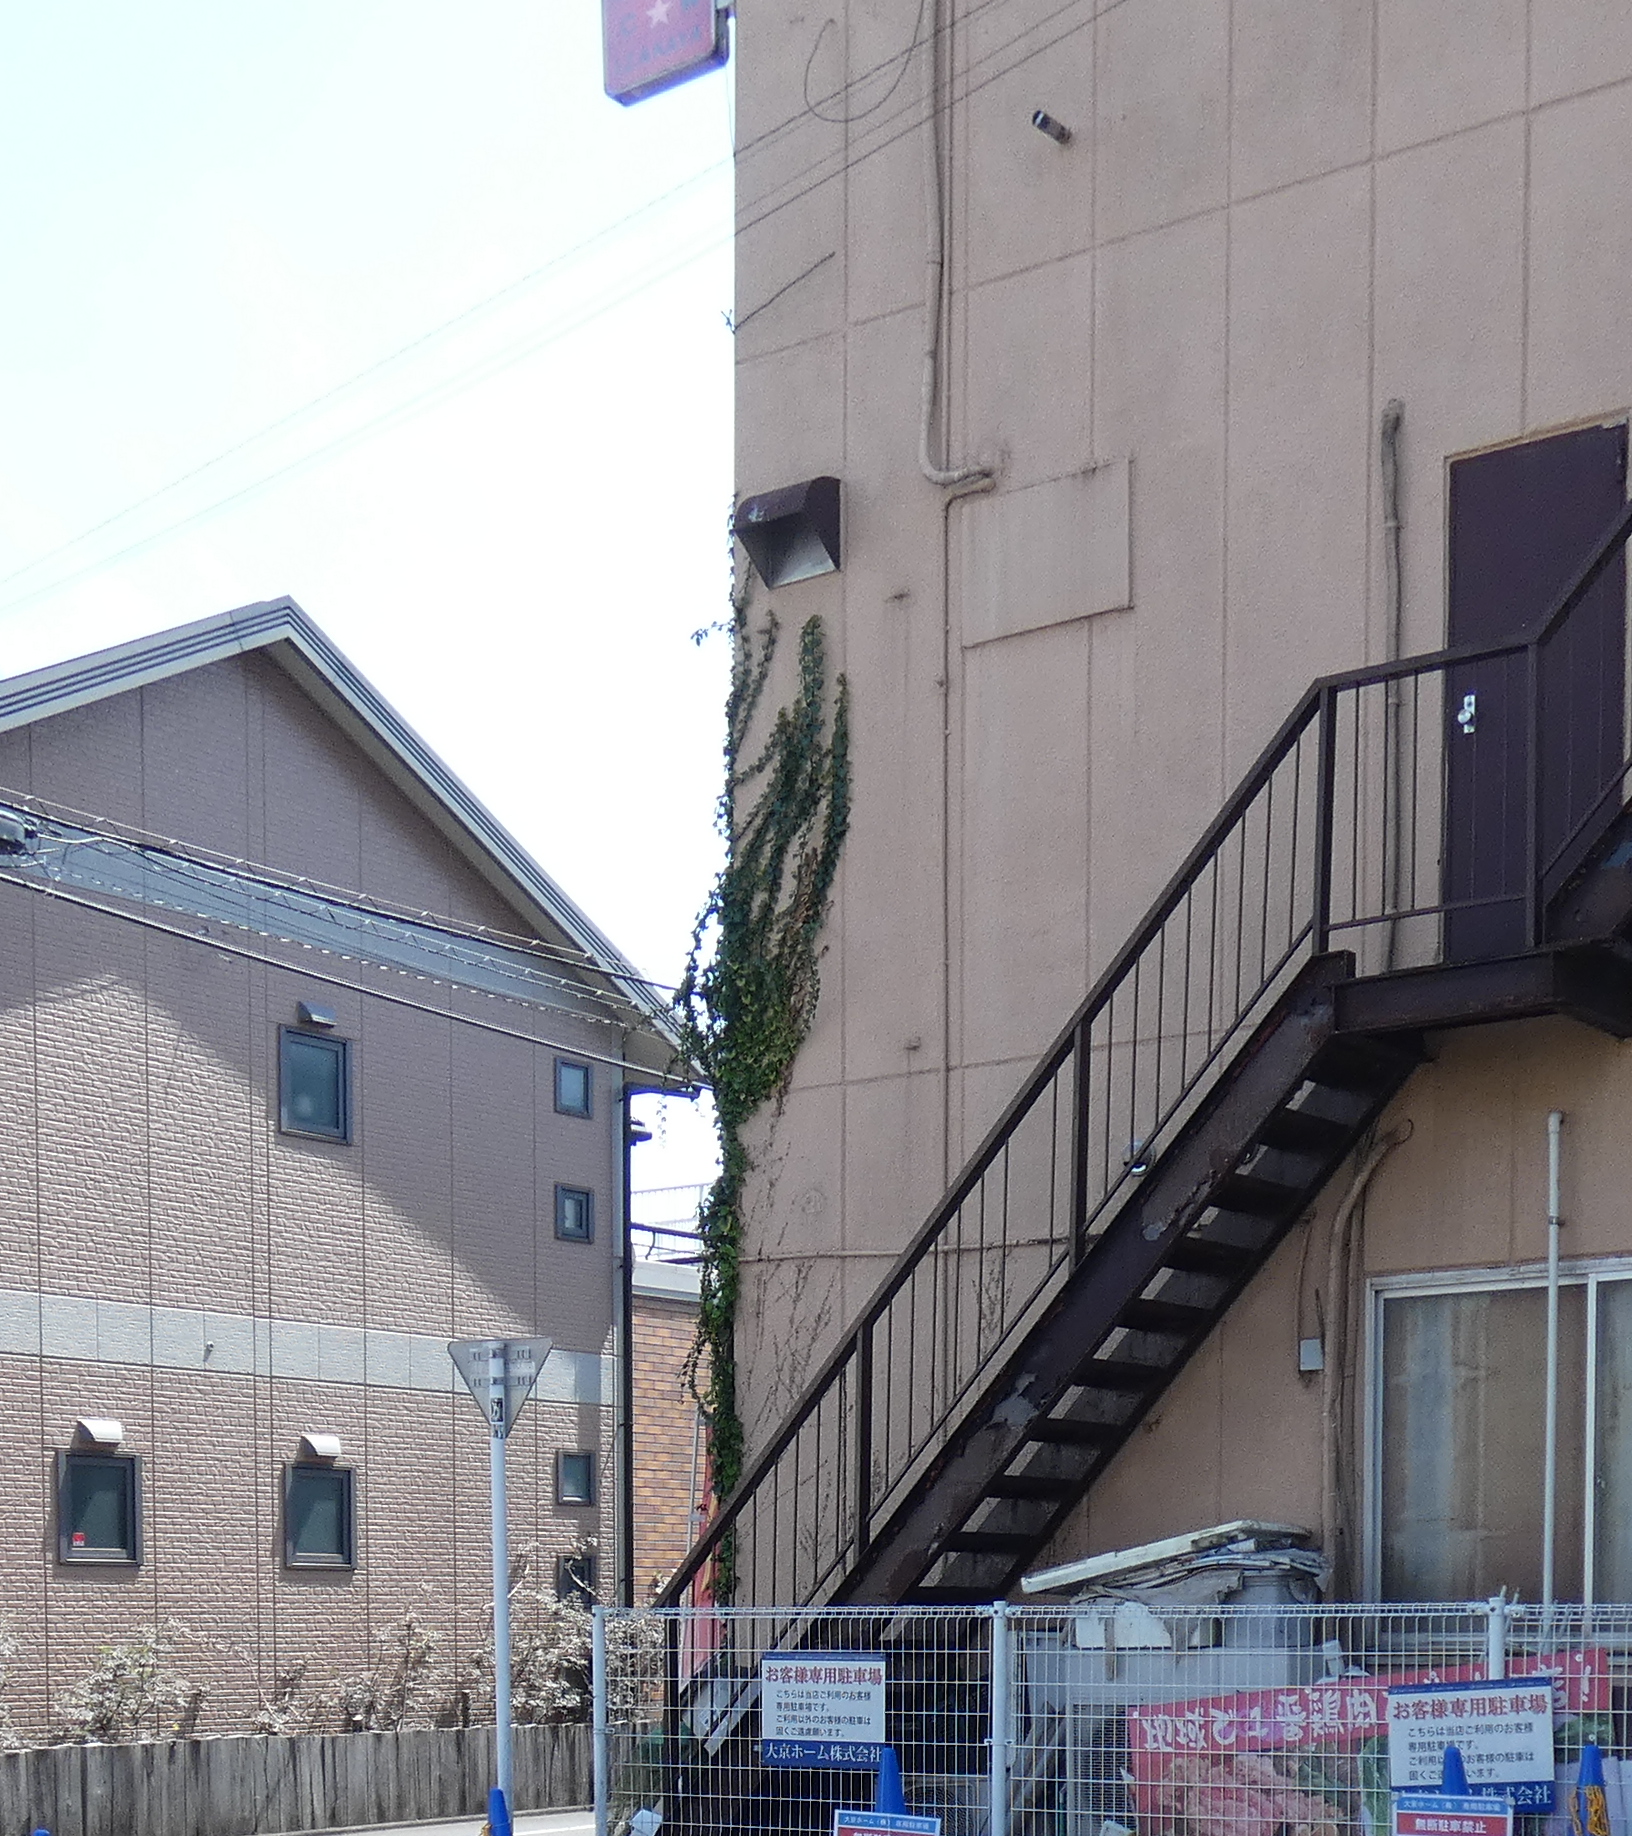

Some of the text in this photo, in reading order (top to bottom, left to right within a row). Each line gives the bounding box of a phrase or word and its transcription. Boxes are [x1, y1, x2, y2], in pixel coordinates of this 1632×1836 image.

[765, 1665, 883, 1685] お客様専用駐車場
[776, 1689, 871, 1701] こちらは当店ご利用のお客様
[1393, 1693, 1548, 1720] お客様専用駐車場
[776, 1714, 871, 1725] ご利用以外のお客様の駐車は
[1408, 1722, 1534, 1738] こちらは当店ご利用のお客様
[765, 1742, 882, 1763] 大京ホーム株式会社
[1415, 1818, 1486, 1834] 無断駐車禁止
